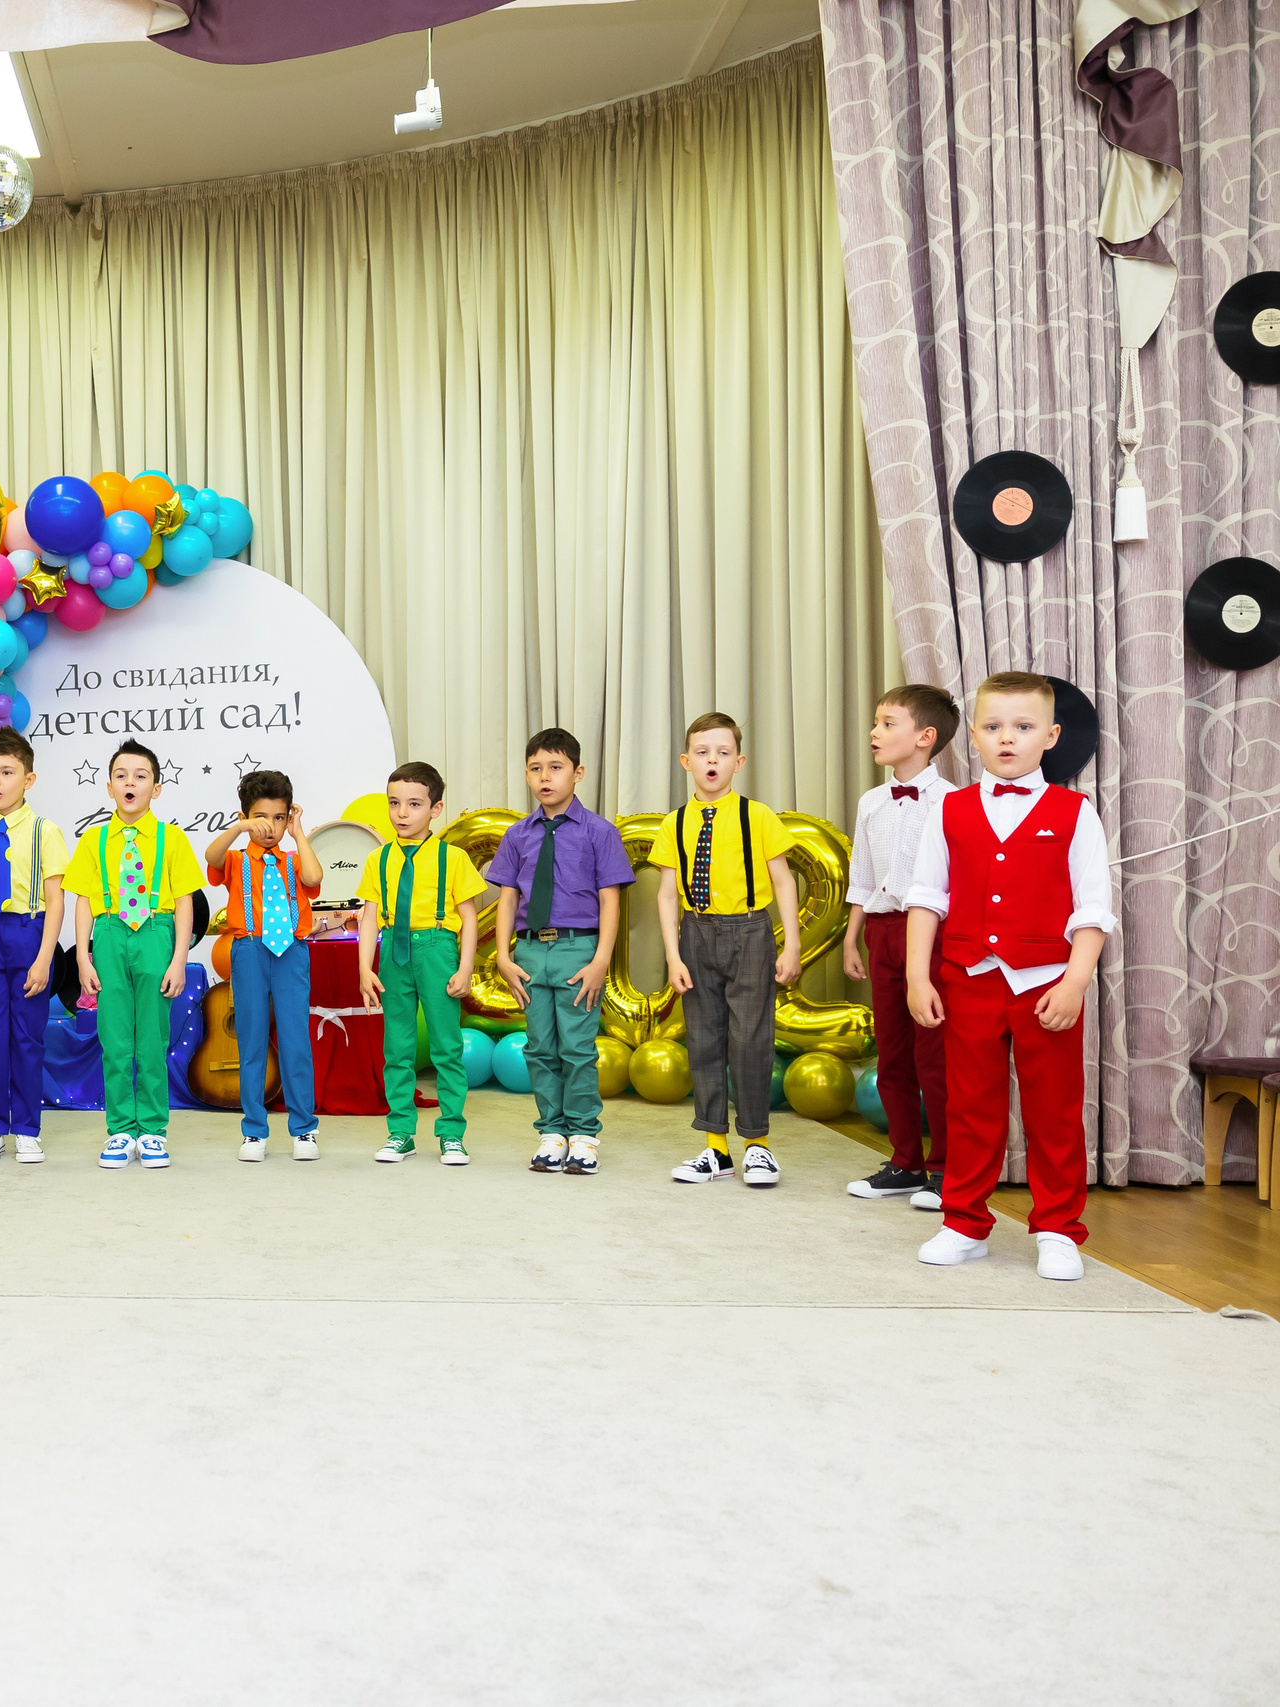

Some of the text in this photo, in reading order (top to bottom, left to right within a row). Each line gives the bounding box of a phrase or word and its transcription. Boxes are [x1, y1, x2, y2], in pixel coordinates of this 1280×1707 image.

[55, 662, 280, 697] До свидания,
[28, 690, 302, 743] детский сад!
[183, 810, 241, 833] 202
[329, 860, 358, 869] Alive
